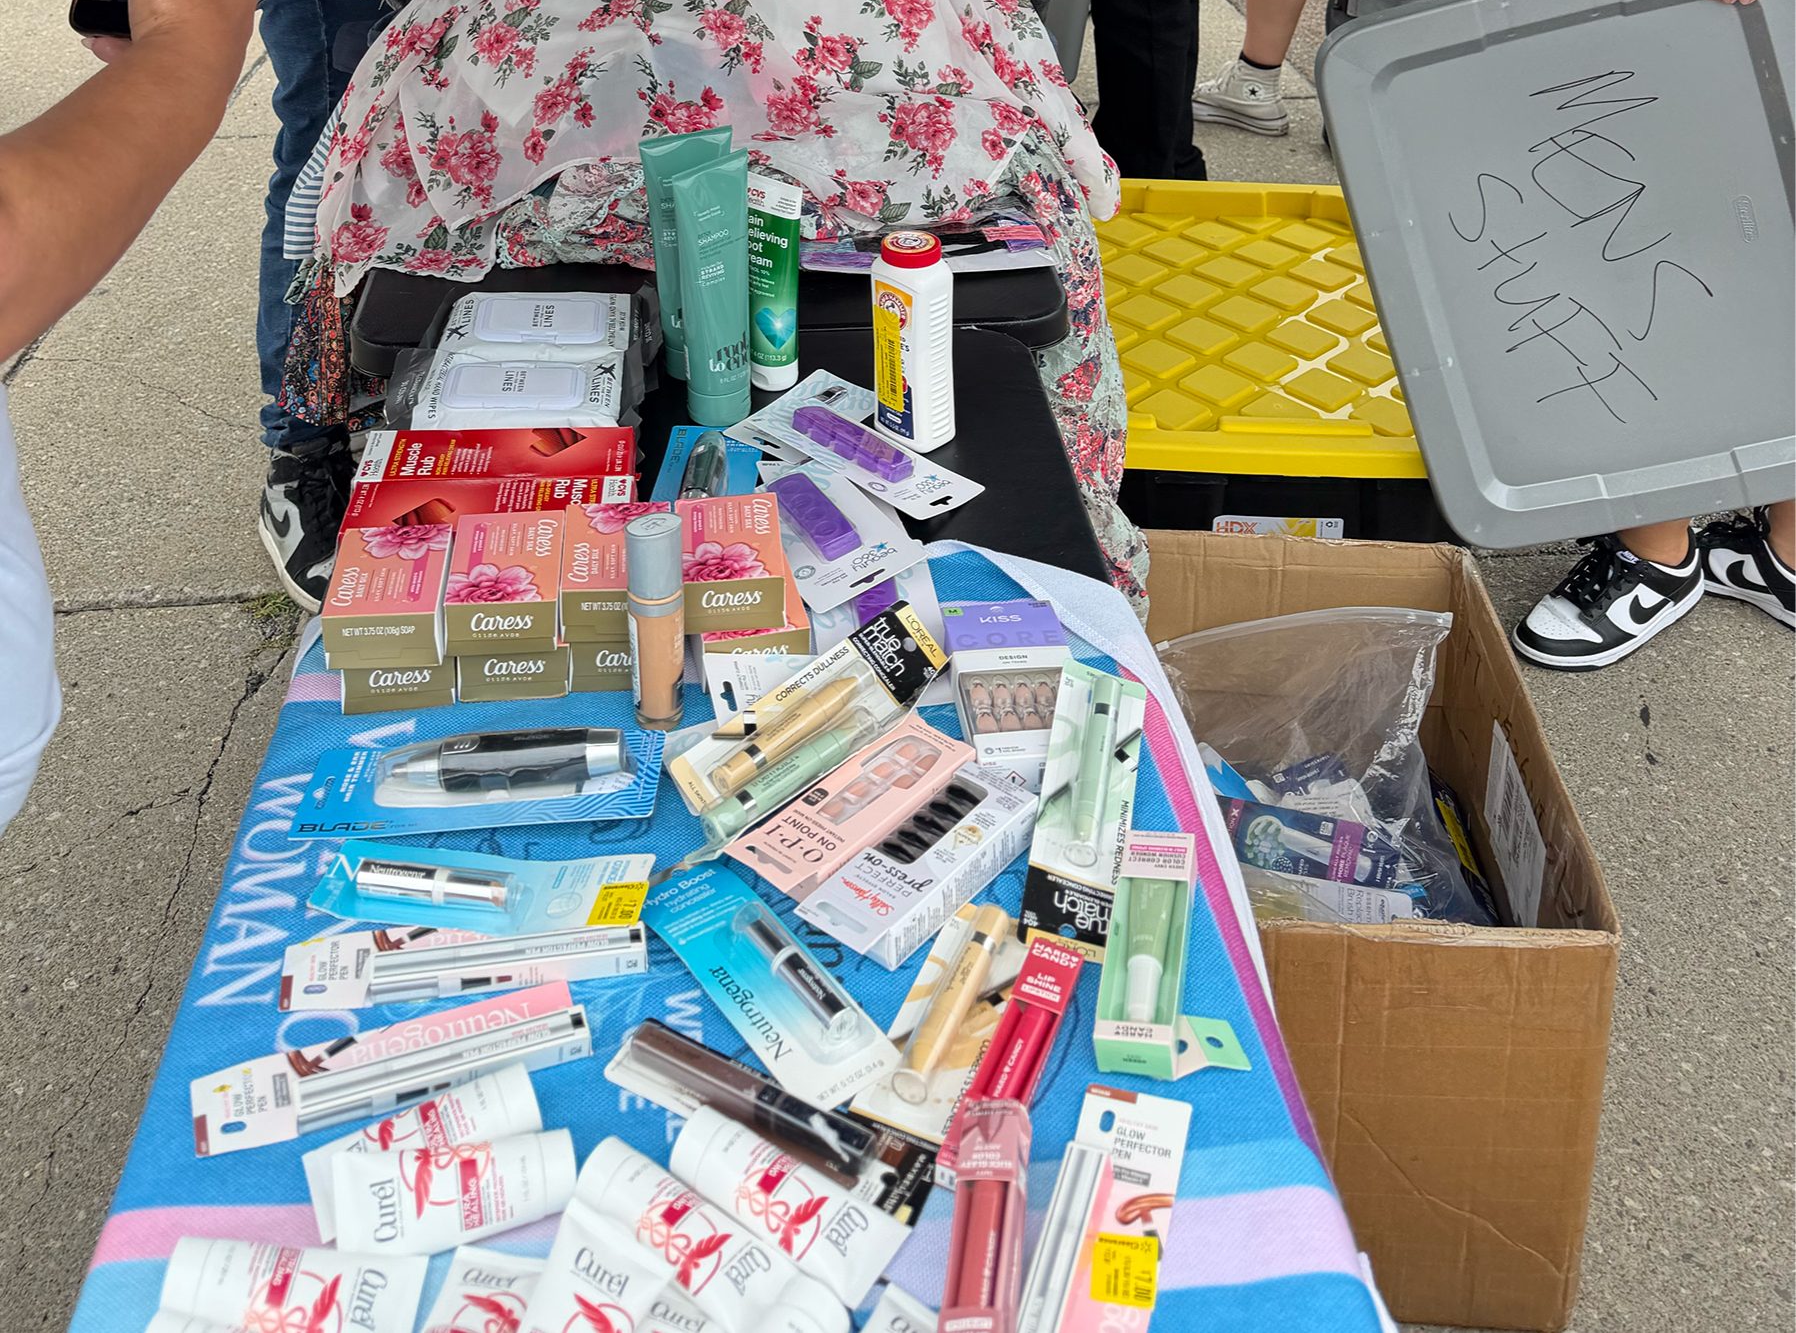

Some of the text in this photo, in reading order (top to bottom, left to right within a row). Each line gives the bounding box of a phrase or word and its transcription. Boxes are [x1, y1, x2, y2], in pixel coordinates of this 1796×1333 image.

[751, 188, 766, 199] CVS
[749, 215, 764, 227] ain
[698, 229, 729, 246] SHAMPOO
[749, 229, 788, 249] elieving
[749, 254, 773, 269] ream
[463, 299, 475, 325] LINES
[532, 304, 541, 327] BETWEEN
[543, 304, 555, 328] LINES
[709, 359, 726, 372] to
[501, 370, 512, 392] LINES
[517, 370, 528, 393] BETWEEN
[589, 370, 601, 404] LINES
[602, 376, 613, 408] BETWEEN
[400, 442, 423, 477] Muscle
[417, 456, 436, 477] Rub
[553, 479, 570, 499] Rub
[616, 484, 628, 497] CVS
[751, 498, 773, 535] Caress
[1216, 521, 1258, 534] HDX
[535, 518, 558, 557] Caress
[568, 542, 590, 583] Caress
[850, 546, 898, 574] beauty
[331, 567, 360, 607] Caress
[581, 602, 592, 612] NET
[592, 602, 601, 611] WT
[601, 601, 614, 611] 3.75
[701, 590, 760, 609] Caress
[471, 612, 532, 632] Caress
[980, 614, 1022, 624] KISS
[342, 628, 353, 636] NET
[363, 627, 376, 636] 3.75
[376, 627, 385, 635] OZ
[400, 626, 416, 635] SOAP
[874, 617, 901, 649] true
[955, 630, 1062, 649] CORE
[861, 625, 906, 678] match
[484, 658, 543, 677] Caress
[775, 646, 850, 703] CORRECTS DULLNESS
[853, 637, 896, 691] CORRECTING CONCEALER
[368, 669, 430, 688] Caress
[298, 820, 389, 835] BLADE
[782, 815, 838, 852] ON POINT
[1110, 799, 1130, 885] MINIMIZES REDNESS
[1128, 856, 1160, 864] CORRECT
[370, 864, 426, 880] Neutrogena
[854, 862, 913, 897] PERFECT
[863, 851, 934, 893] press-on
[603, 883, 638, 892] Clearance
[641, 868, 717, 910] Hydro Boost
[663, 882, 711, 910] hydrating
[842, 876, 896, 917] Sally Hansen
[669, 887, 717, 915] concealer
[1075, 913, 1109, 934] rue
[328, 940, 340, 981] PERFECTOR
[1031, 949, 1077, 969] CANDY
[1033, 941, 1064, 959] HARD
[317, 960, 328, 981] GLOW
[339, 965, 349, 980] PEN
[1037, 971, 1056, 983] LIP
[1026, 975, 1062, 994] SHINE
[709, 966, 793, 1063] Neutrogena
[1115, 1024, 1153, 1032] CANDY
[1007, 1038, 1025, 1067] CANDY
[234, 1093, 245, 1118] GLOW
[257, 1095, 269, 1112] PEN
[1116, 1127, 1146, 1141] GLOW
[1111, 1148, 1132, 1161] PEN
[1114, 1137, 1173, 1159] PERFECTOR
[369, 1176, 400, 1244] Curél
[825, 1205, 870, 1258] Curél
[1099, 1237, 1141, 1252] Clearance
[462, 1267, 519, 1289] Curél
[573, 1245, 631, 1298] Curél
[724, 1245, 772, 1297] Curél
[351, 1267, 388, 1332] Curél
